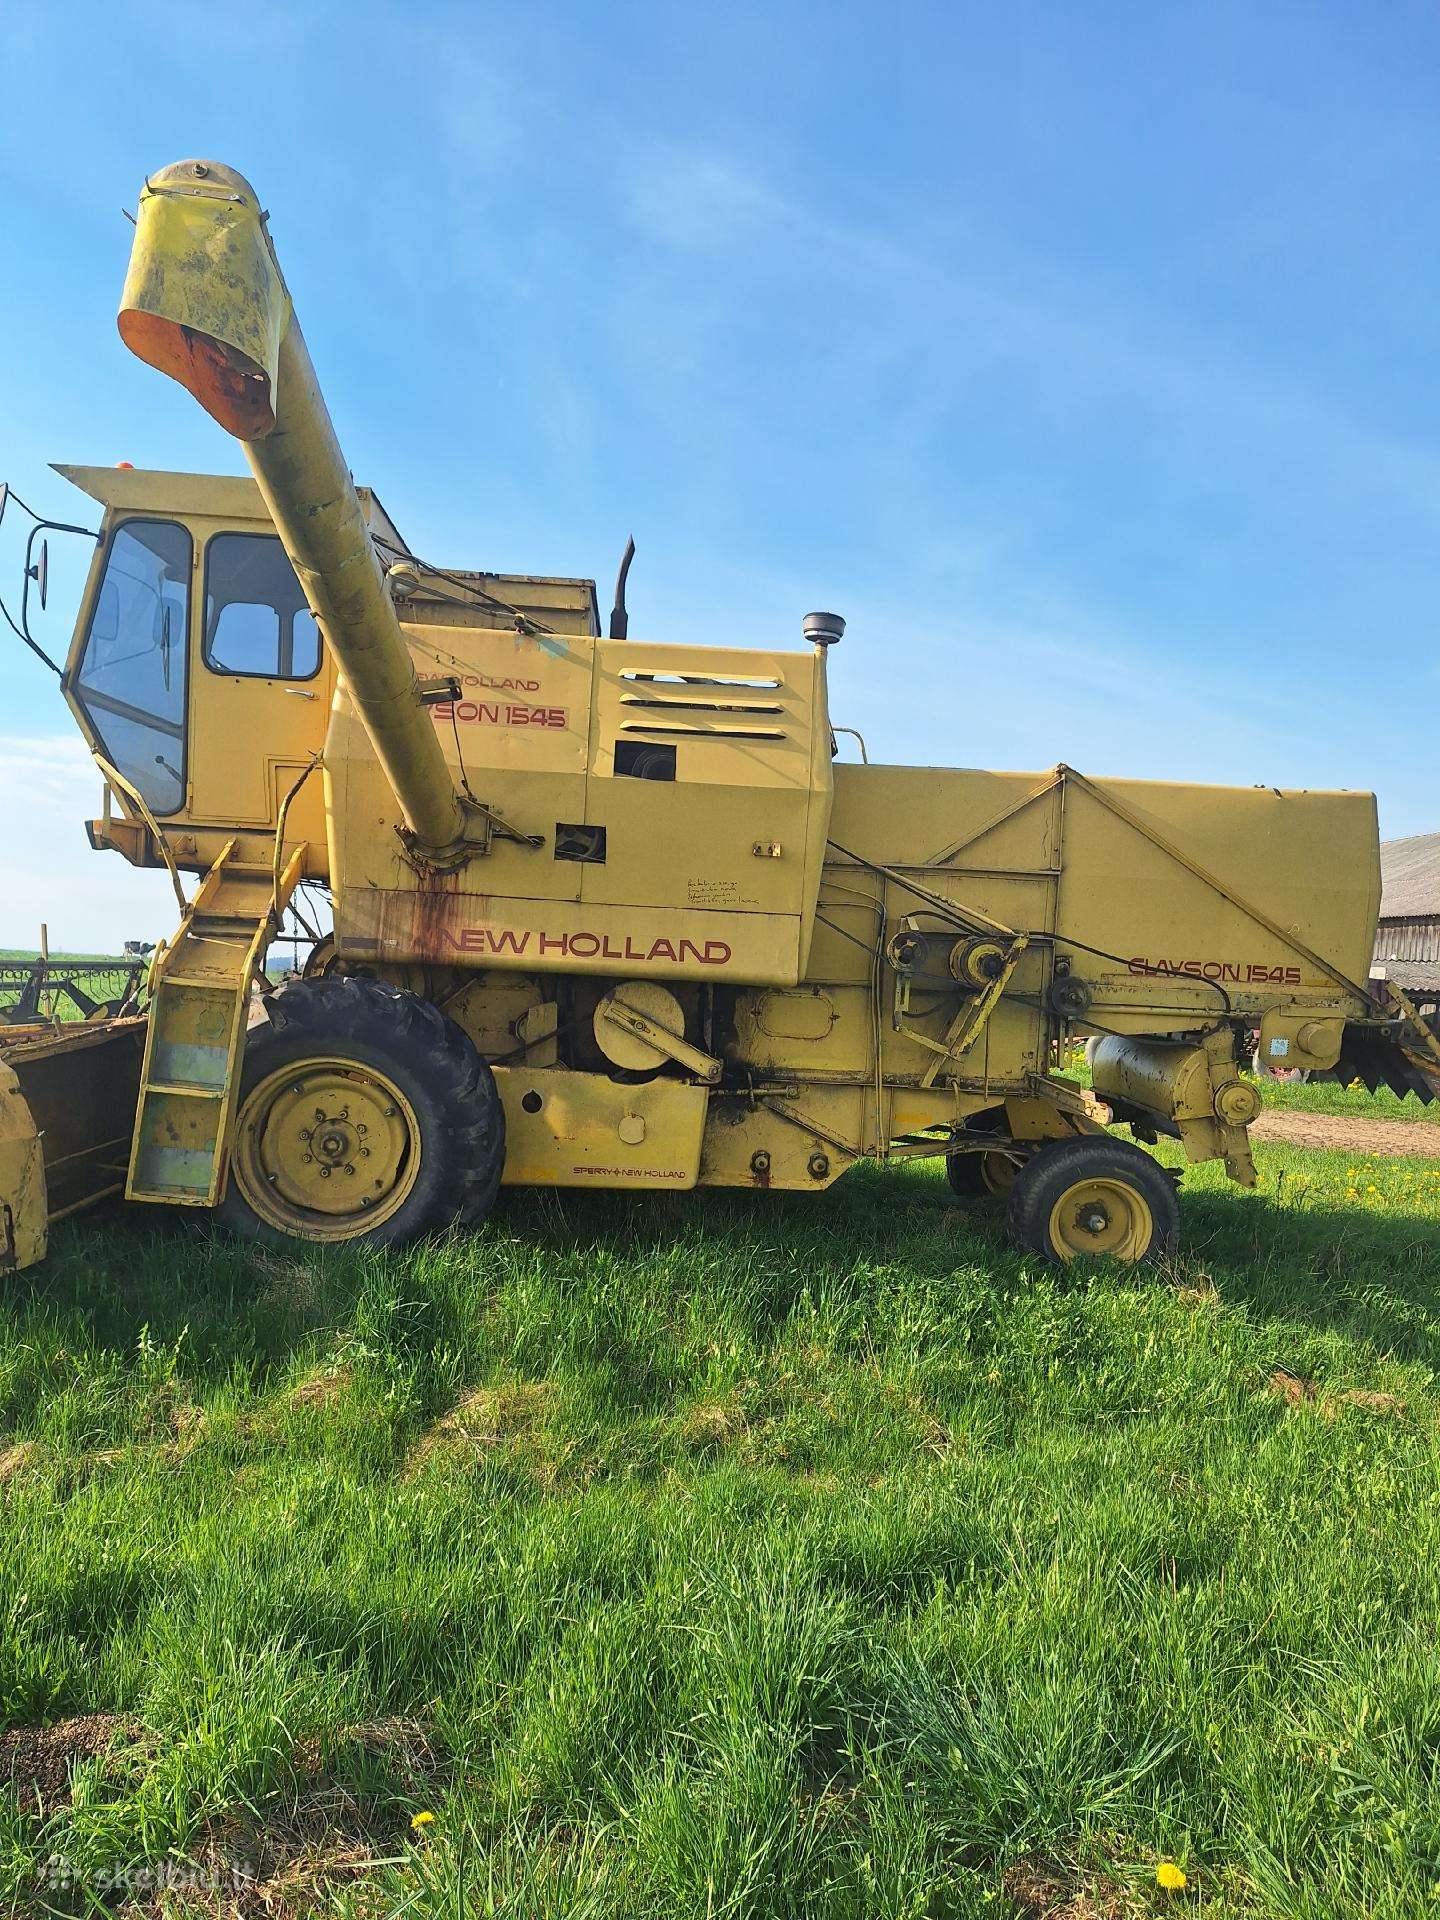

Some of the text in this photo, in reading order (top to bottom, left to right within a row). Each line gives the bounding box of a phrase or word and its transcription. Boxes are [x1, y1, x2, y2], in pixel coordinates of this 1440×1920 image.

[505, 706, 566, 728] 1545
[441, 929, 732, 965] NEW HOLLAND
[1246, 964, 1301, 984] 1545
[573, 1166, 686, 1179] SPERRY NEW HOLLAND
